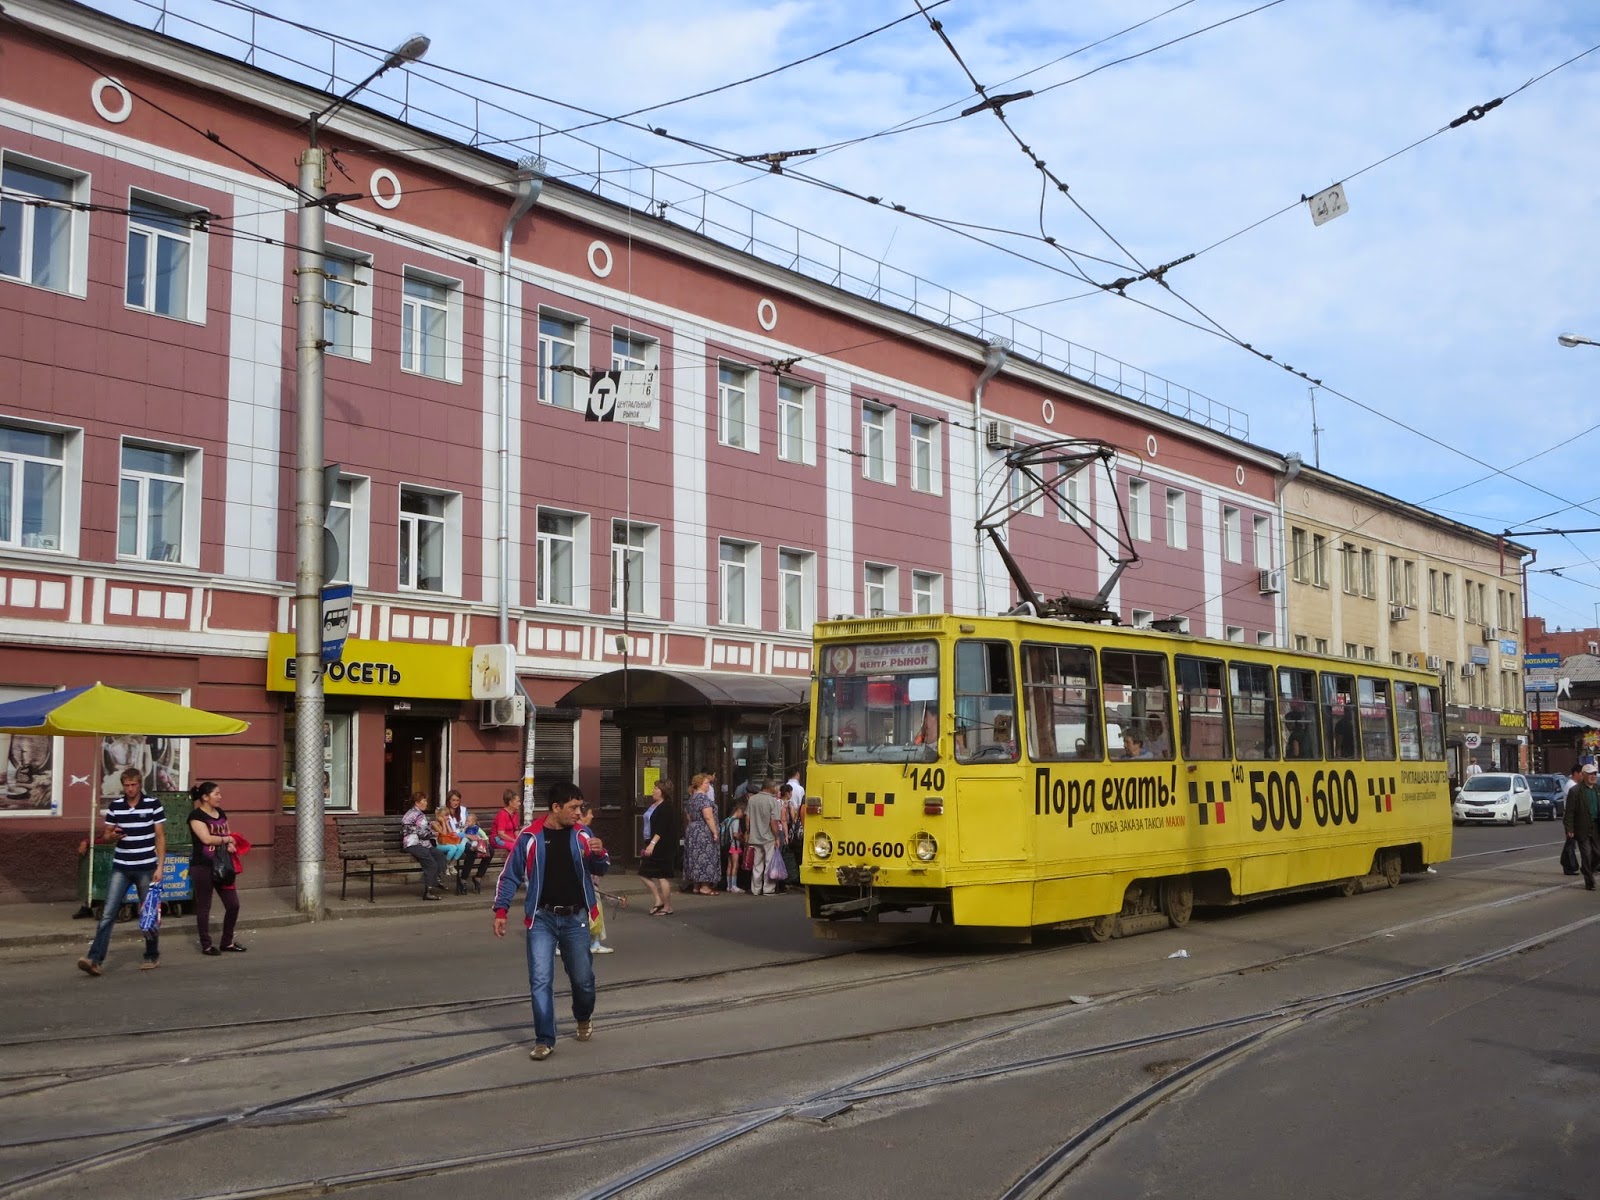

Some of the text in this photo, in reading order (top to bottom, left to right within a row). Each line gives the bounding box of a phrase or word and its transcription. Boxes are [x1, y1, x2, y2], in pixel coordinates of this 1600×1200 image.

[648, 372, 654, 383] 3
[645, 385, 651, 396] 6
[617, 400, 652, 409] ЦЕНТРАЛЬНЫЙ
[622, 410, 640, 419] РЫНОК
[863, 644, 930, 657] ВОЛЖСКАЯ
[890, 655, 928, 668] РЫНОК
[1524, 657, 1559, 665] НОТАРИУС
[285, 658, 401, 685] ЕОСЕТЬ
[642, 745, 666, 755] ВХОД
[909, 767, 946, 792] 140
[1231, 765, 1245, 784] 140
[1035, 765, 1177, 828] Пора ехать!
[1090, 821, 1119, 836] СЛУЖБА
[1119, 820, 1144, 834] ЗАКАЗА
[1144, 818, 1165, 831] ТАКСИ
